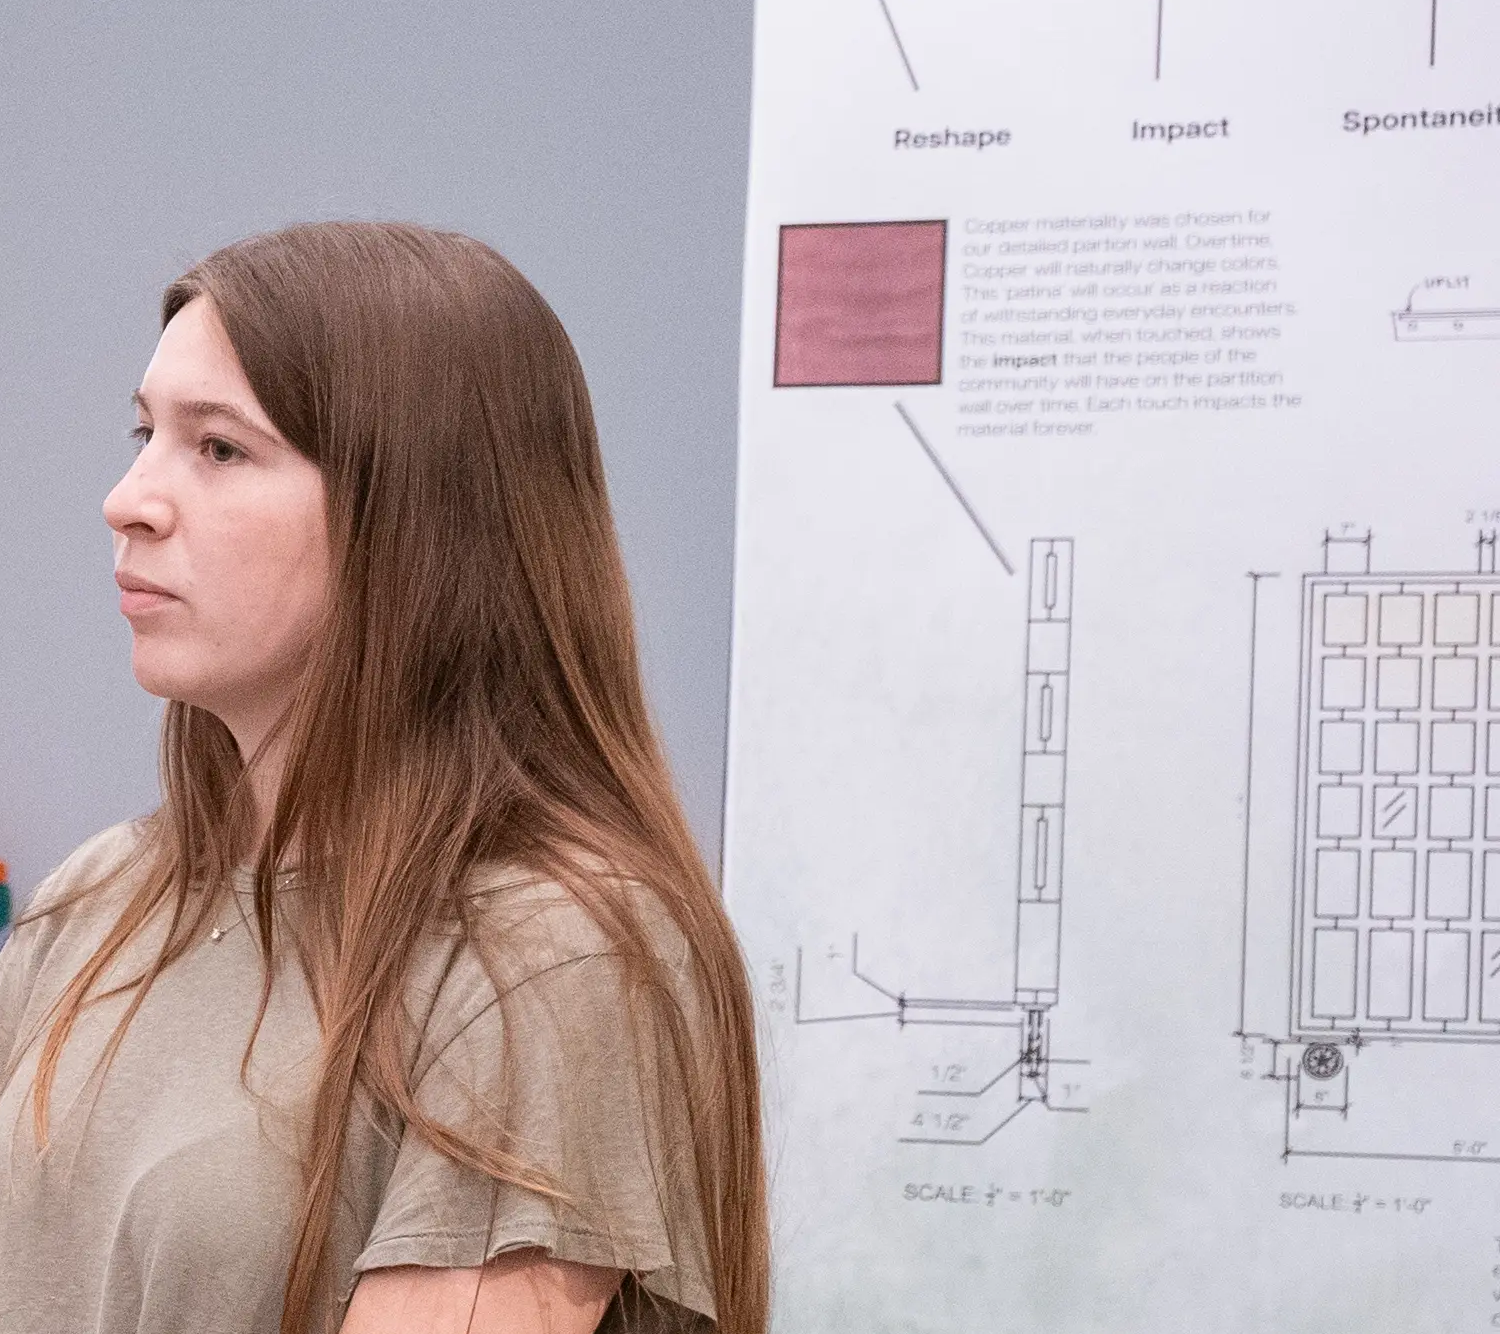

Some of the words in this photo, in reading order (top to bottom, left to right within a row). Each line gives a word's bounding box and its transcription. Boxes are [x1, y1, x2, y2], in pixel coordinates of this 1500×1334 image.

[893, 125, 1012, 151] Reshape
[1131, 116, 1231, 142] Impact
[963, 217, 1030, 234] Copper
[1036, 214, 1128, 232] materiality
[1132, 216, 1170, 228] was
[1174, 212, 1243, 227] chosen
[1247, 209, 1271, 224] for
[964, 244, 992, 257] our
[998, 239, 1069, 255] detailed
[963, 262, 1028, 279] Copper
[1034, 260, 1061, 275] will
[1066, 258, 1142, 276] naturally
[1146, 256, 1216, 275] change
[964, 285, 998, 301] This
[1070, 282, 1099, 298] will
[1103, 283, 1154, 297] occur
[1160, 284, 1181, 297] as
[1186, 283, 1197, 295] a
[1201, 278, 1278, 295] reaction
[960, 309, 979, 324] of
[984, 305, 1099, 326] withstanding
[1102, 304, 1184, 323] everyday
[962, 330, 997, 346] This
[1081, 327, 1131, 343] when
[1220, 325, 1282, 340] shows
[961, 353, 988, 368] the
[992, 352, 1058, 369] impact
[1064, 351, 1098, 366] that
[1103, 350, 1131, 365] the
[1136, 349, 1199, 367] people
[1204, 348, 1222, 364] of
[1228, 347, 1257, 362] the
[958, 376, 1058, 396] community
[1064, 373, 1092, 388] will
[1096, 372, 1140, 387] have
[1145, 374, 1167, 387] on
[1173, 371, 1202, 386] the
[1207, 370, 1284, 388] partition
[958, 398, 991, 414] wall
[996, 400, 1033, 414] over
[1086, 396, 1131, 411] Each
[1136, 395, 1189, 410] touch
[1193, 394, 1267, 412] impacts
[1272, 392, 1303, 408] the
[958, 421, 1029, 437] material
